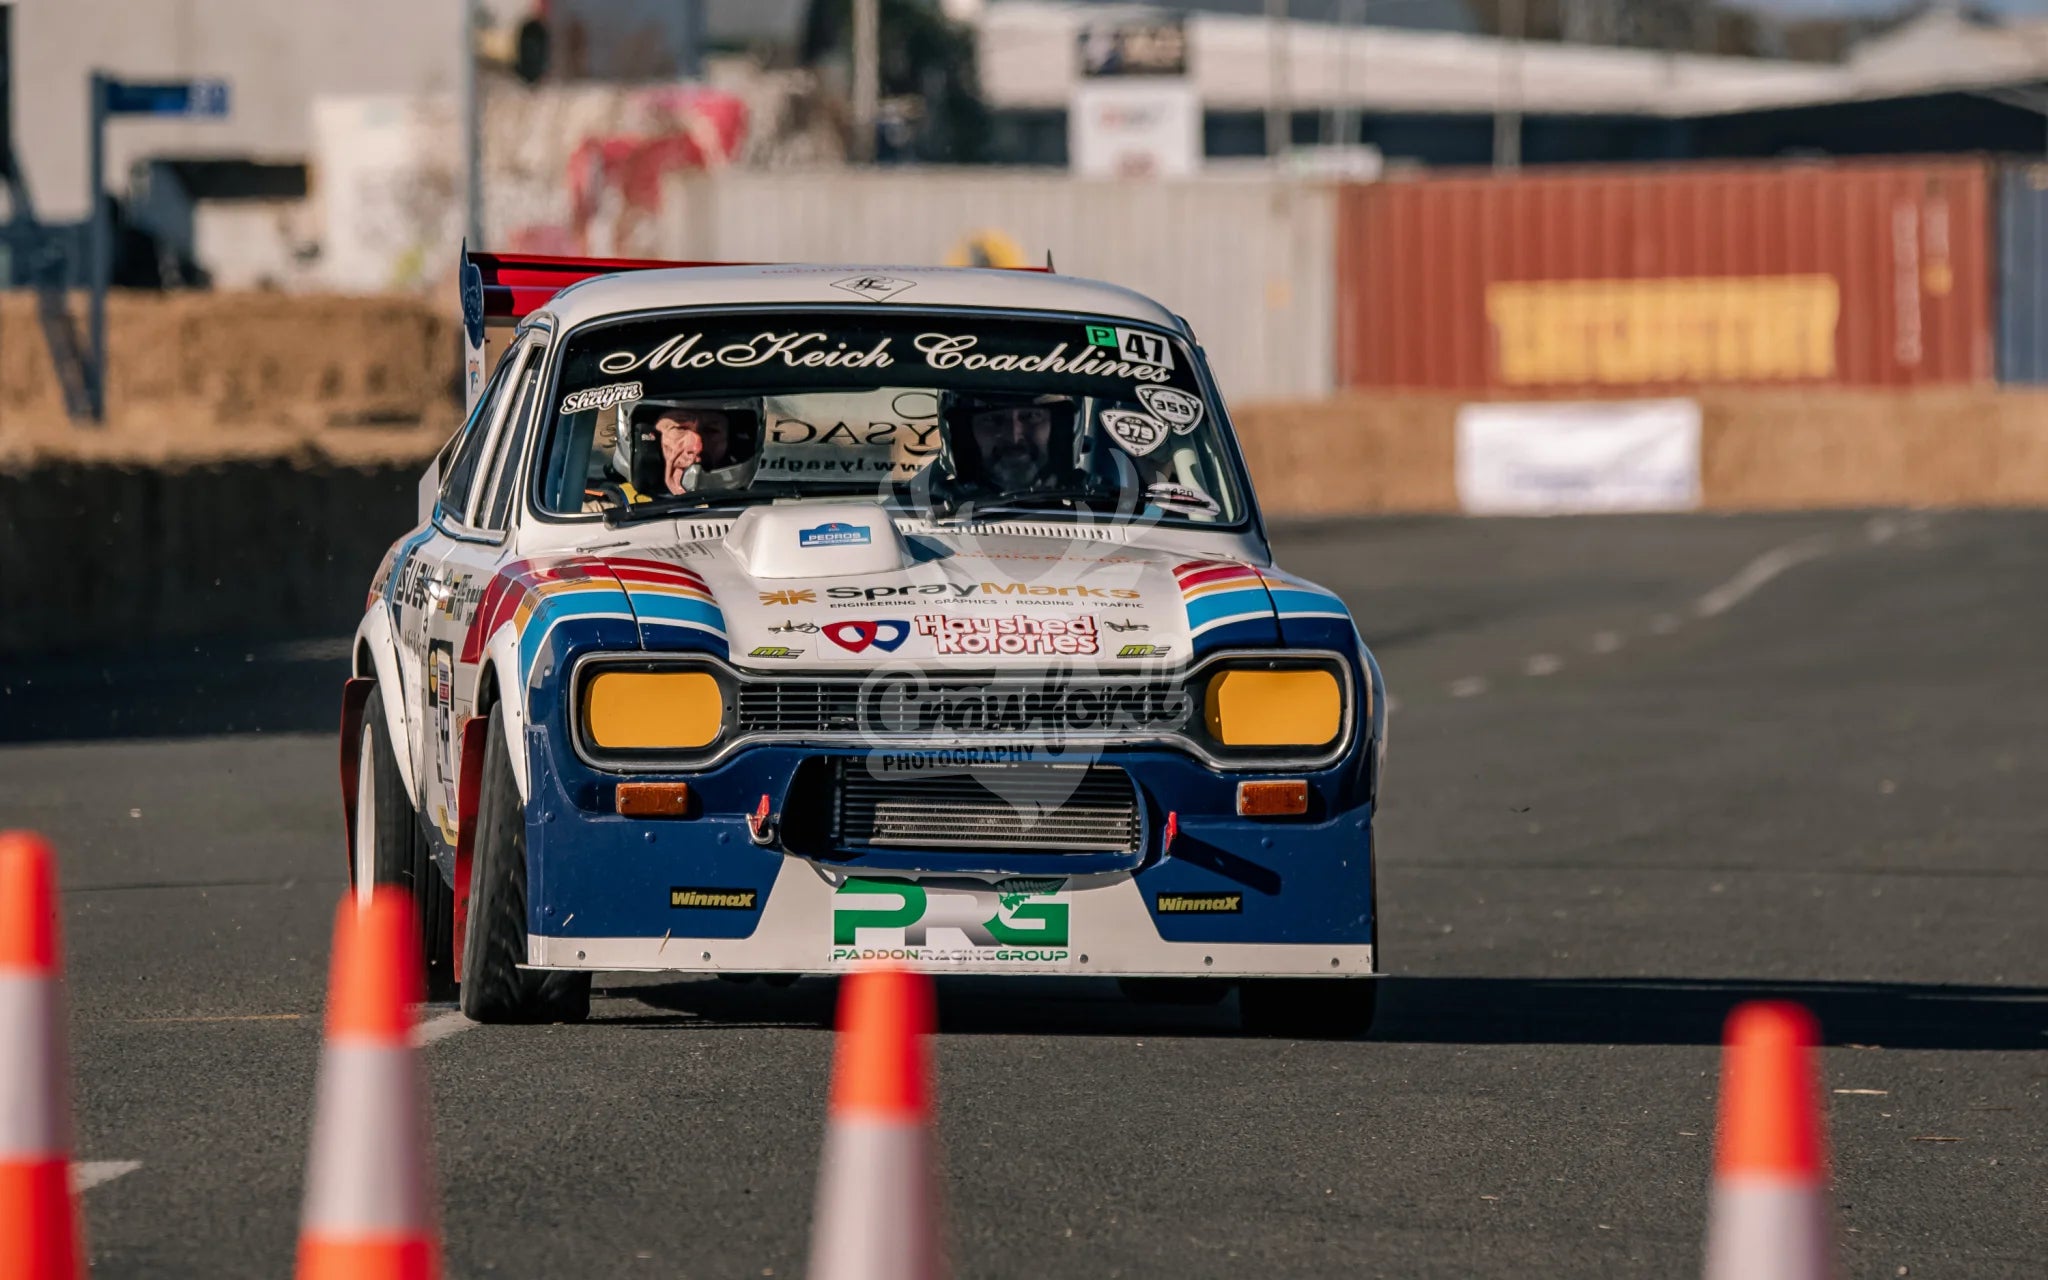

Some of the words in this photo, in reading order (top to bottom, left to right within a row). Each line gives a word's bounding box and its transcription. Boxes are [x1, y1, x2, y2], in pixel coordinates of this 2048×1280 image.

[599, 331, 893, 376] McKeich
[913, 332, 1171, 384] Coachlines
[1091, 329, 1110, 346] P
[1125, 332, 1166, 364] 47
[563, 387, 639, 412] Shayne
[1154, 399, 1190, 417] 359
[1116, 421, 1154, 441] 379
[808, 532, 861, 541] PEDROS
[826, 582, 1141, 600] SprayMarks
[830, 600, 916, 608] ENGINEERING
[934, 597, 998, 605] GRAPHICS
[914, 614, 1098, 641] Hayshed
[833, 876, 1069, 947] PRG
